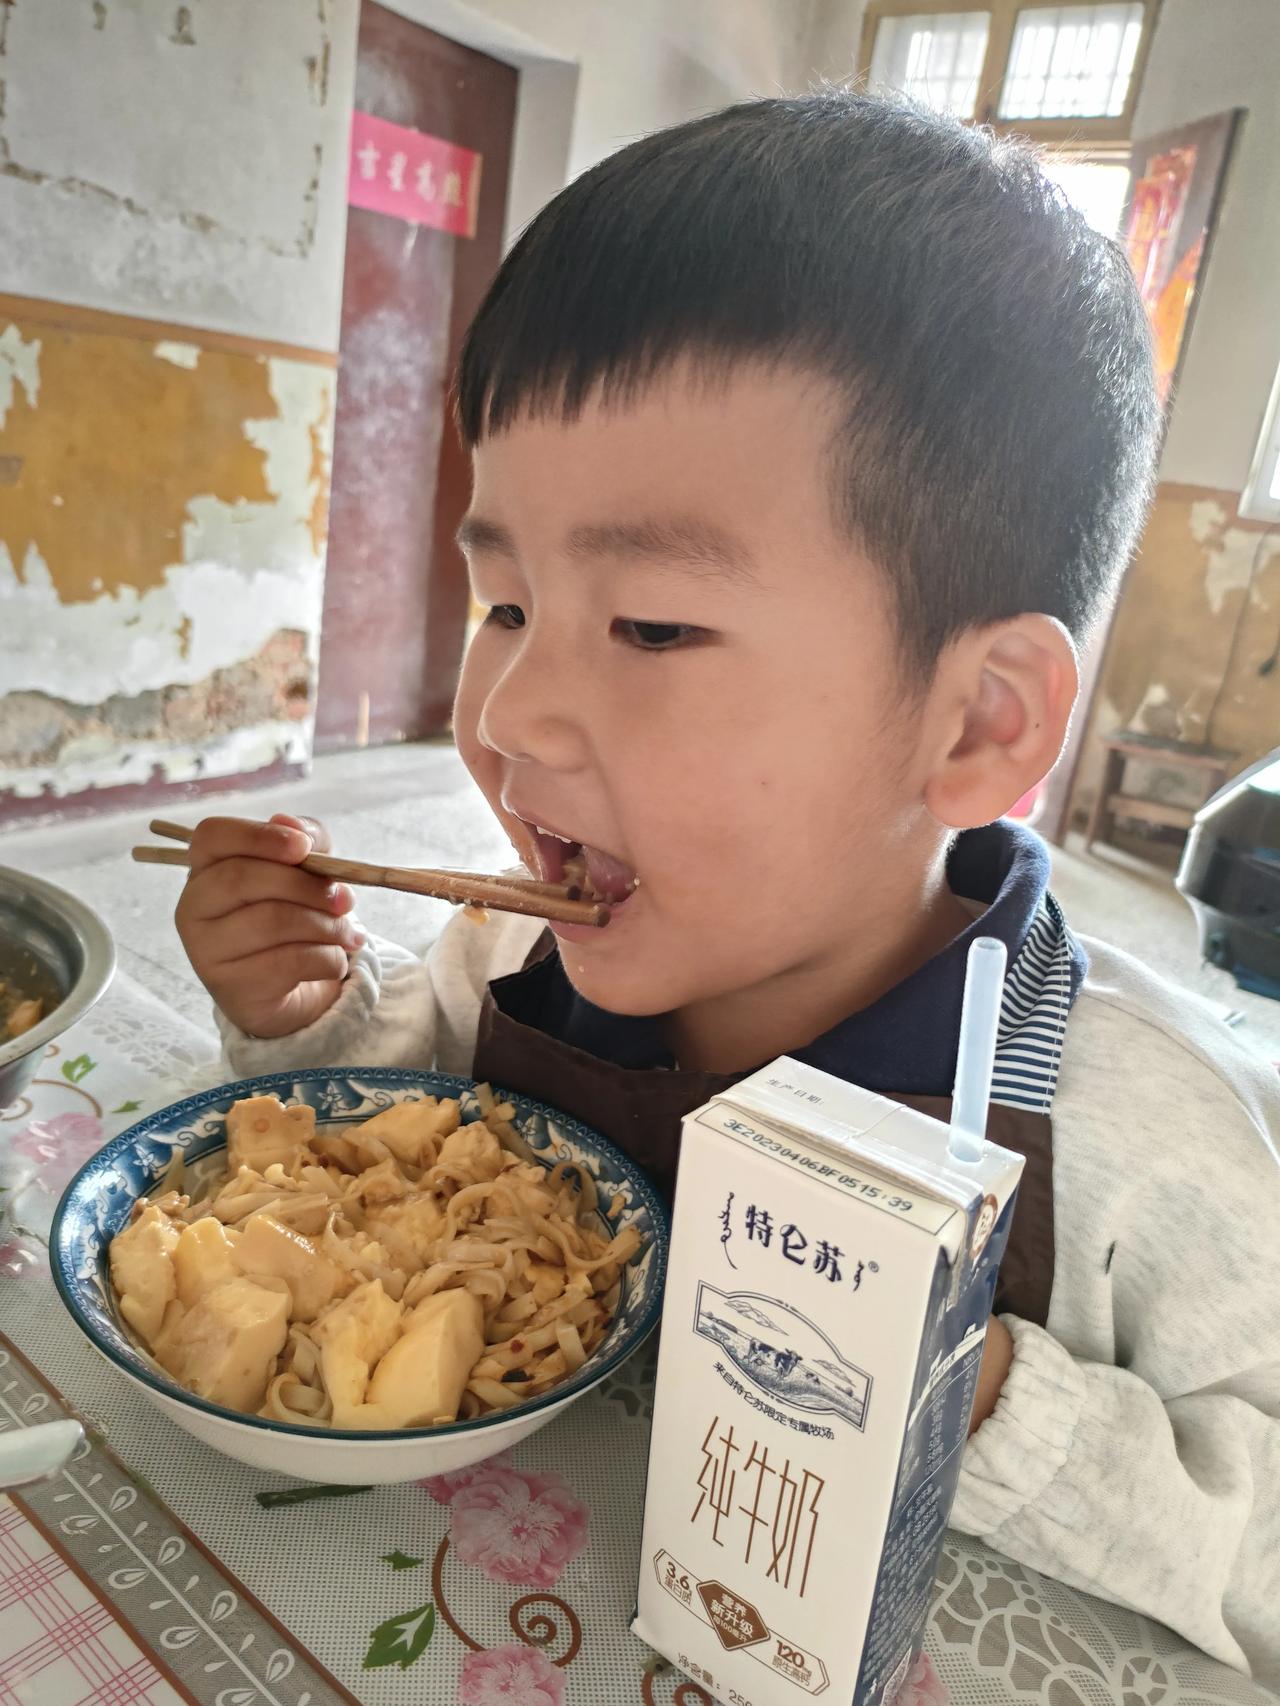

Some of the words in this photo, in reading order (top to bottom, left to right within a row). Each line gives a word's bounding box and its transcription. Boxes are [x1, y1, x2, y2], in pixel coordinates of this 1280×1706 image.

[745, 1204, 847, 1283] 特仑苏
[690, 1415, 825, 1598] 纯牛奶
[709, 1598, 754, 1639] 新升级
